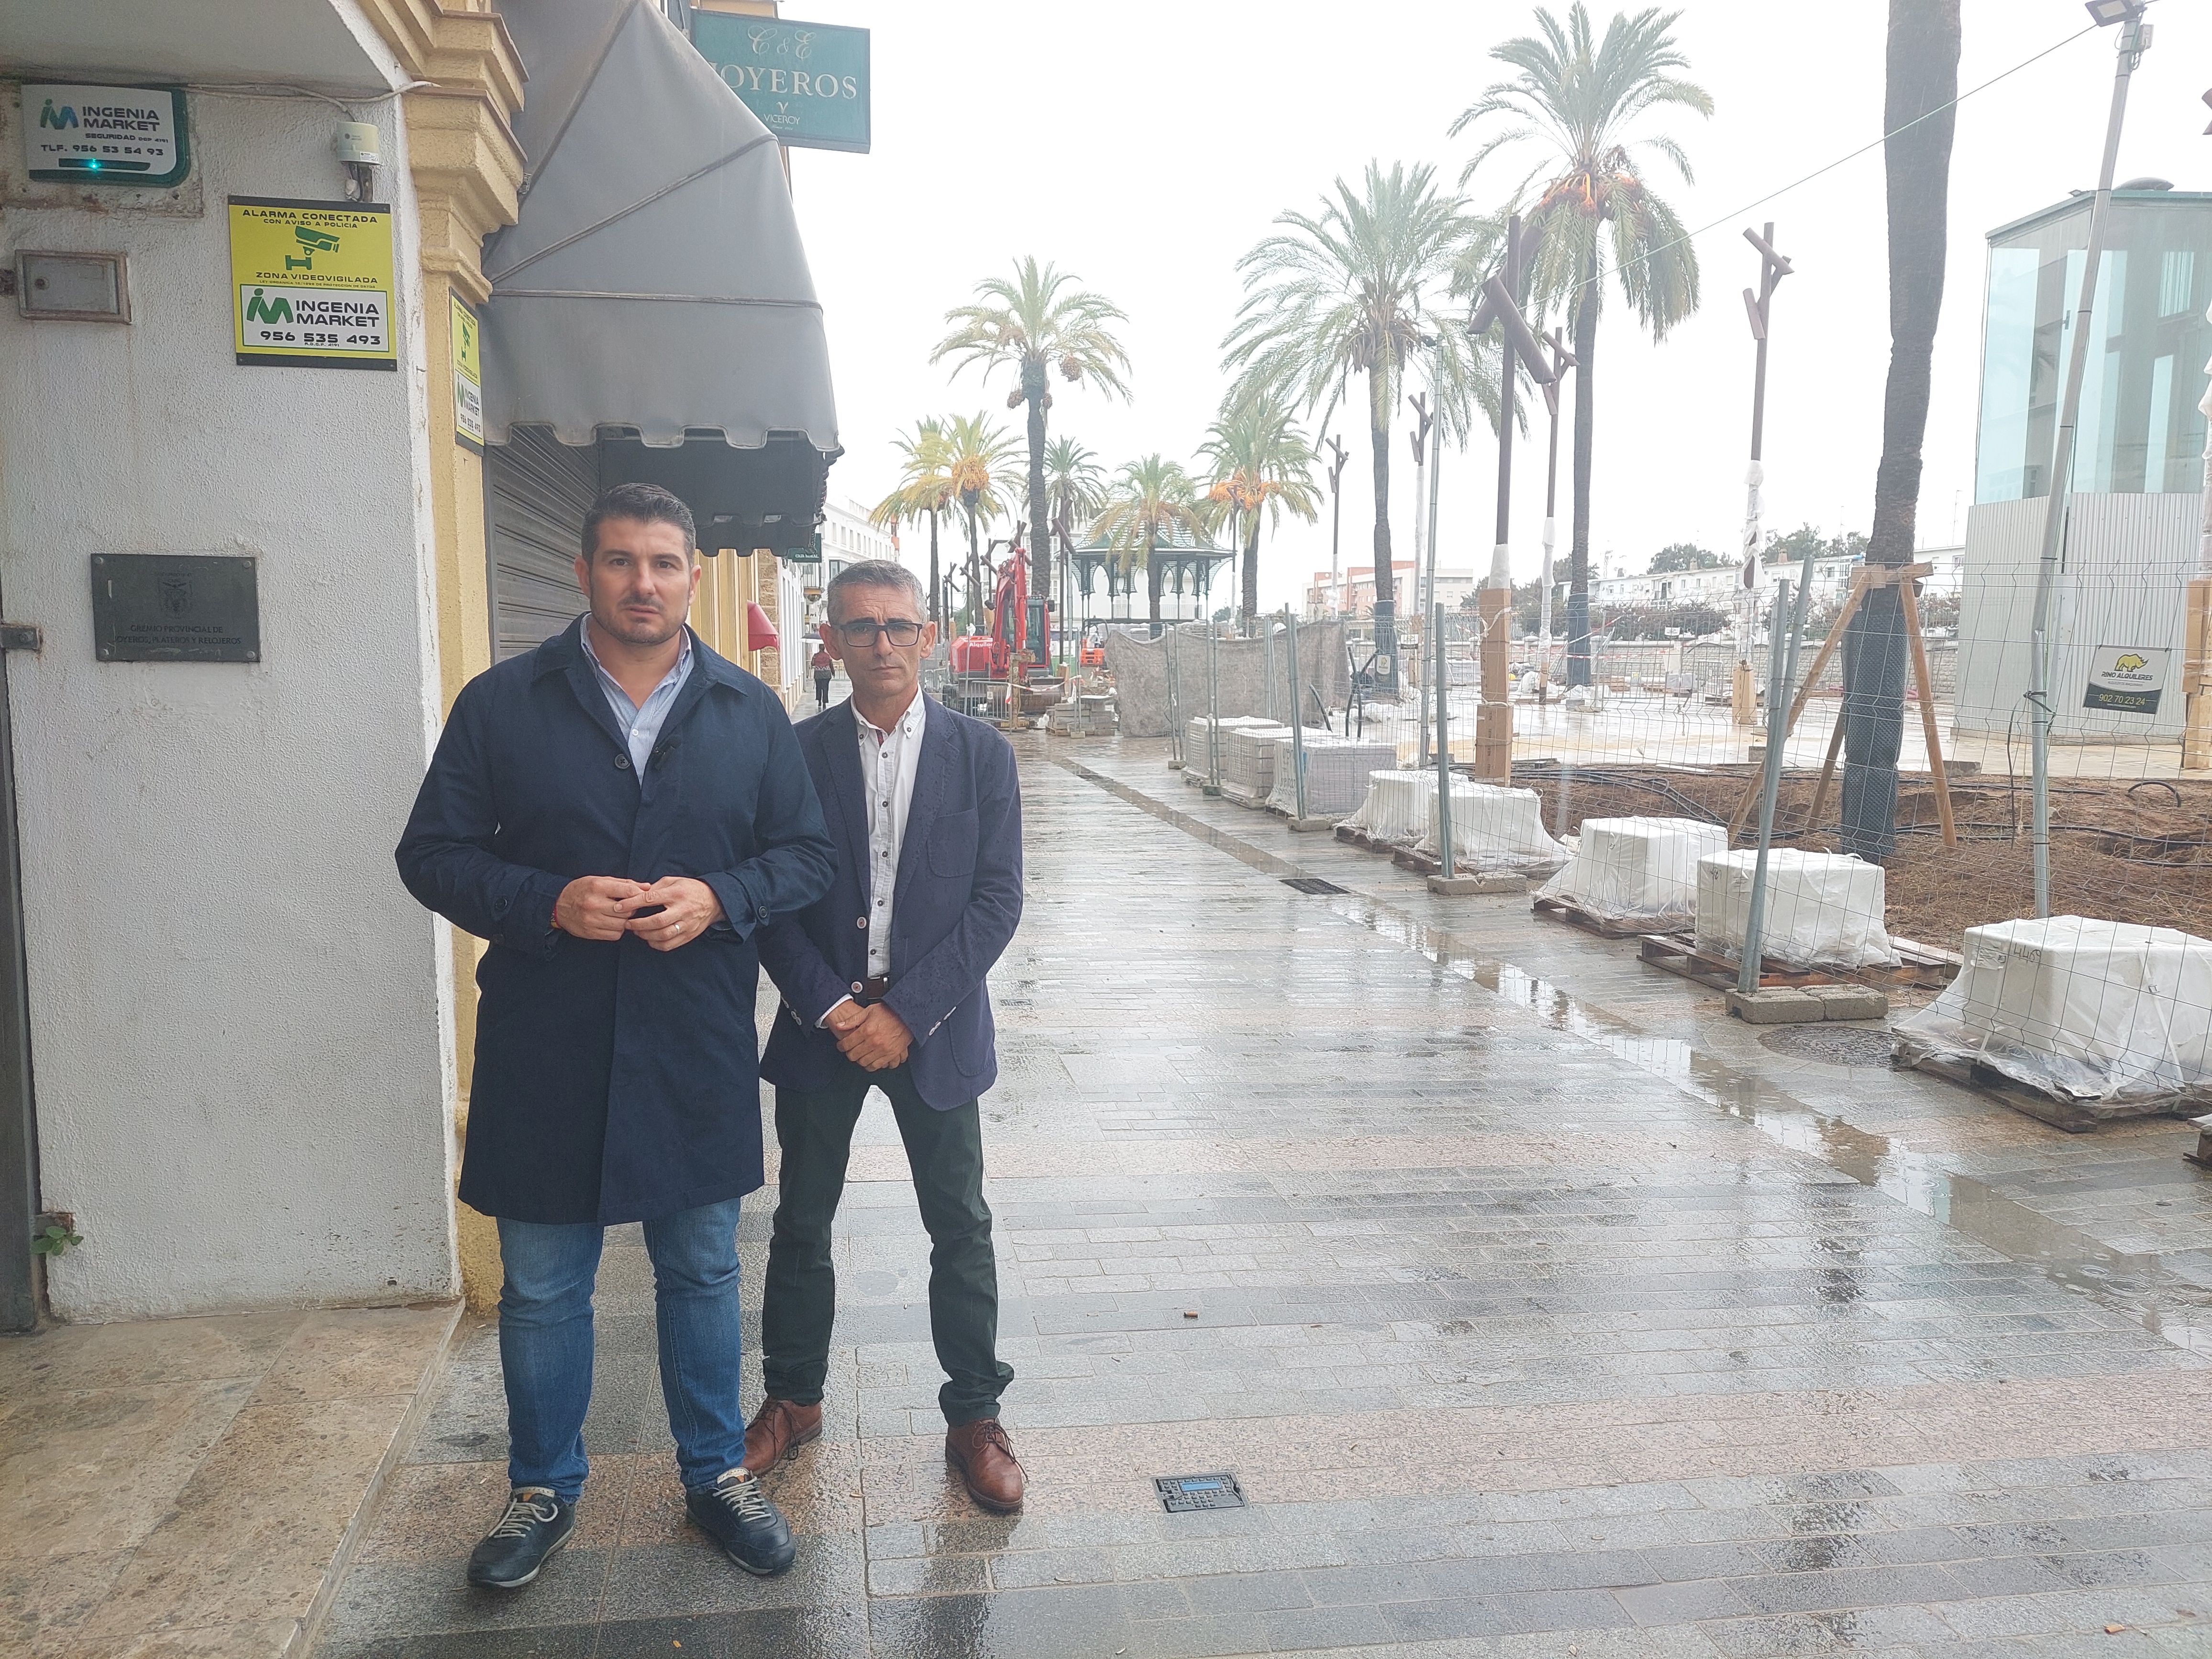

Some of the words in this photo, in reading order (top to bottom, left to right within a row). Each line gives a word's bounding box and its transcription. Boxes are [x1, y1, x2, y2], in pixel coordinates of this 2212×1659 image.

[82, 106, 159, 120] INGENIA
[764, 114, 800, 125] VICEROY
[83, 118, 160, 132] MARKET
[243, 209, 297, 219] ALARMA
[302, 213, 377, 223] CONECTADA
[291, 274, 377, 283] VIDEOVIGILADA
[296, 300, 379, 314] INGENIA
[297, 313, 379, 327] MARKET
[260, 331, 296, 341] 956
[304, 333, 338, 343] 535
[346, 334, 380, 345] 493
[465, 388, 479, 406] INGENIA
[465, 400, 479, 417] MARKET
[2099, 694, 2113, 702] 902
[2114, 695, 2124, 704] 70
[2124, 696, 2134, 705] 23
[2135, 697, 2146, 706] 24
[2014, 942, 2041, 964] 4469
